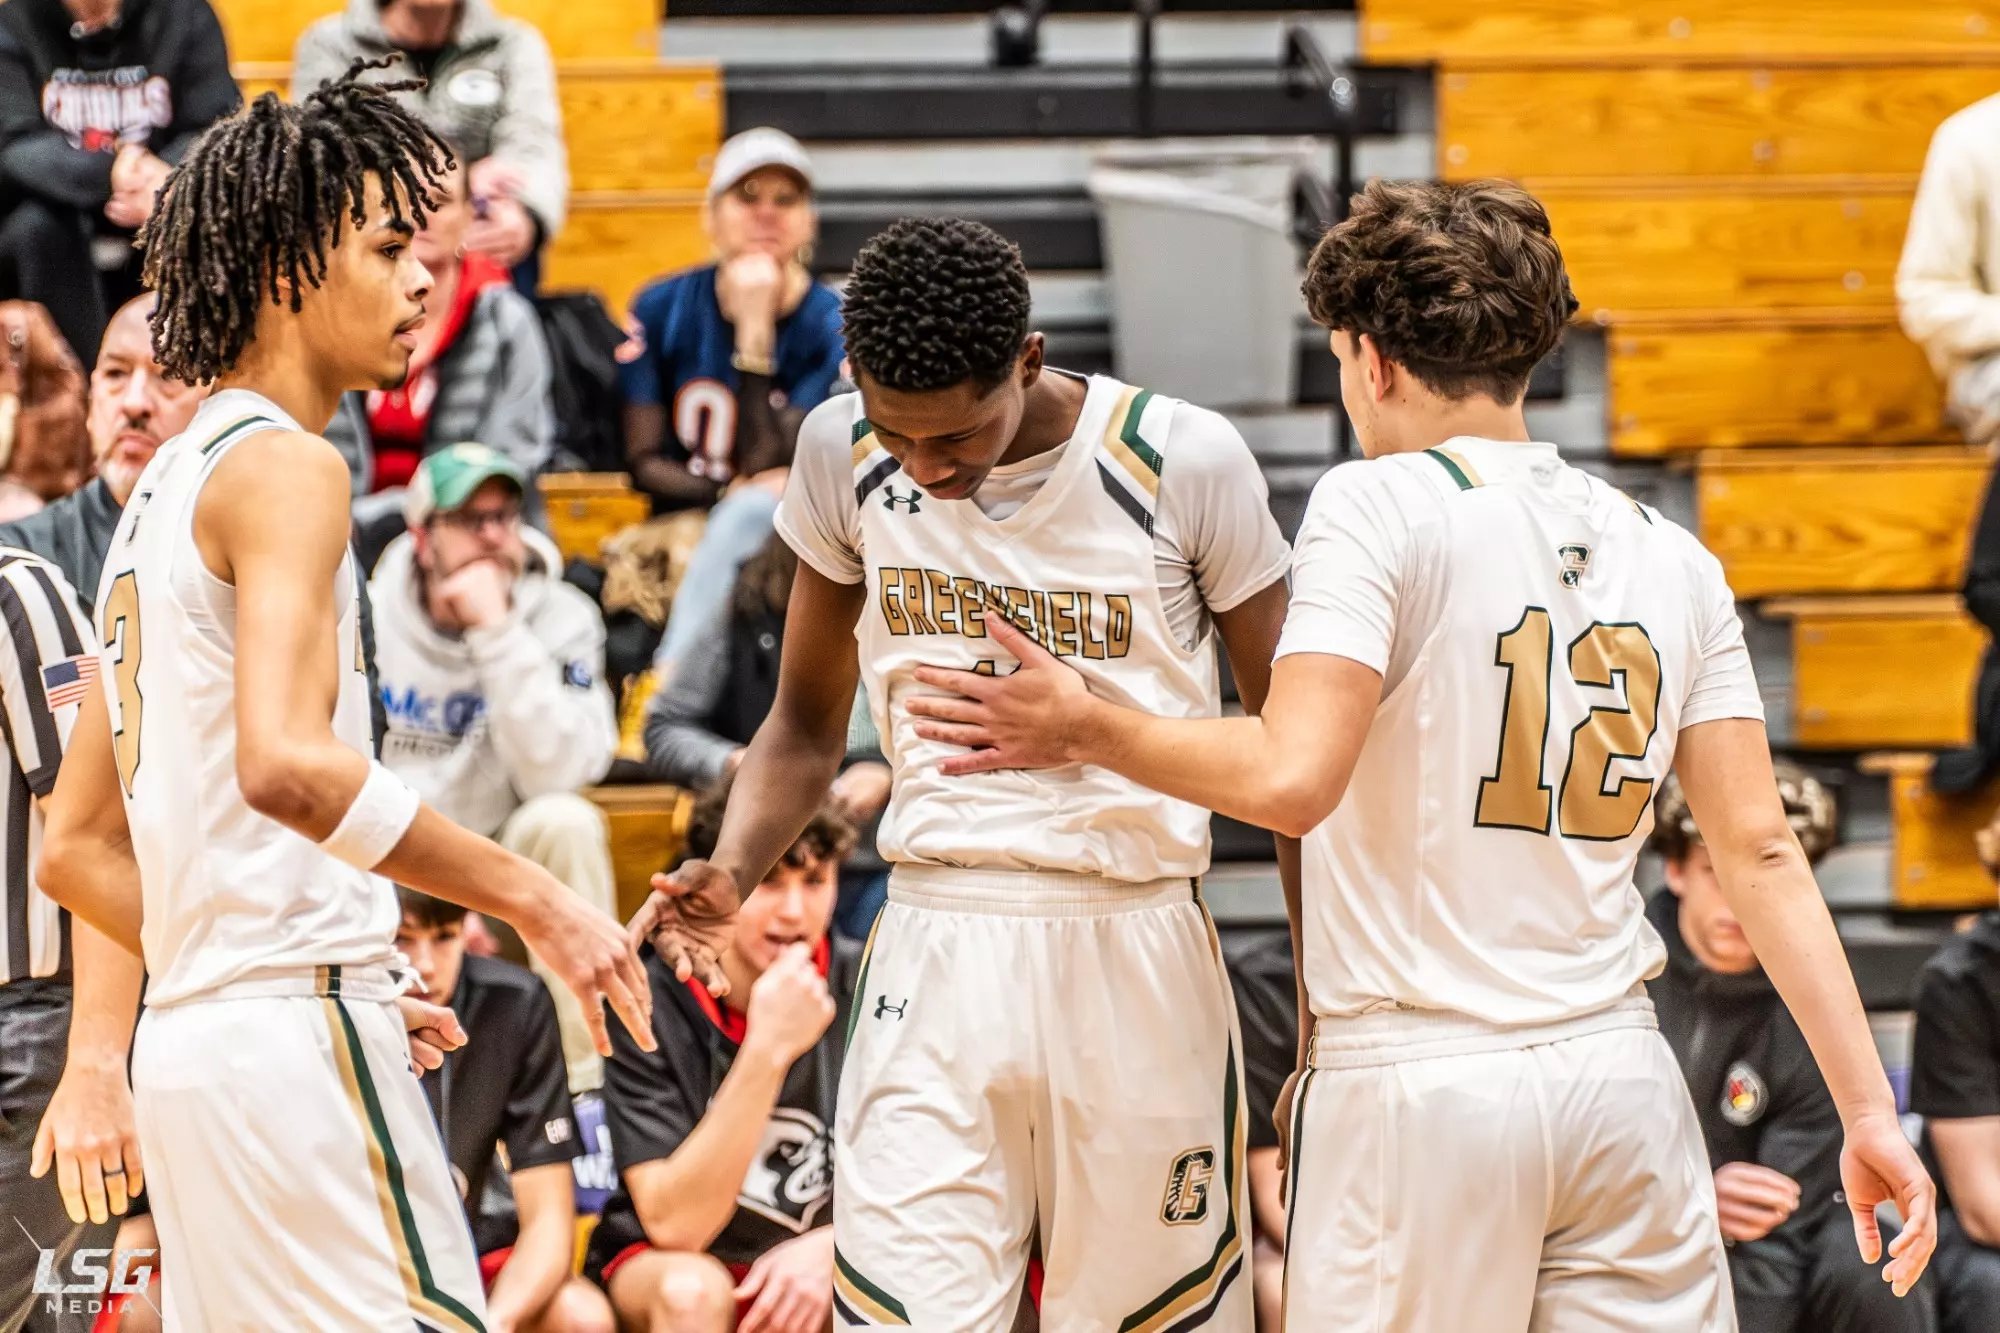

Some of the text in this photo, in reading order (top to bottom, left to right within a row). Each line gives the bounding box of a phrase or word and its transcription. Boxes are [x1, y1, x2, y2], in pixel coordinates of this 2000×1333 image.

[879, 567, 1132, 660] GREENFIELD
[1473, 605, 1662, 842] 12
[1159, 1145, 1217, 1227] G
